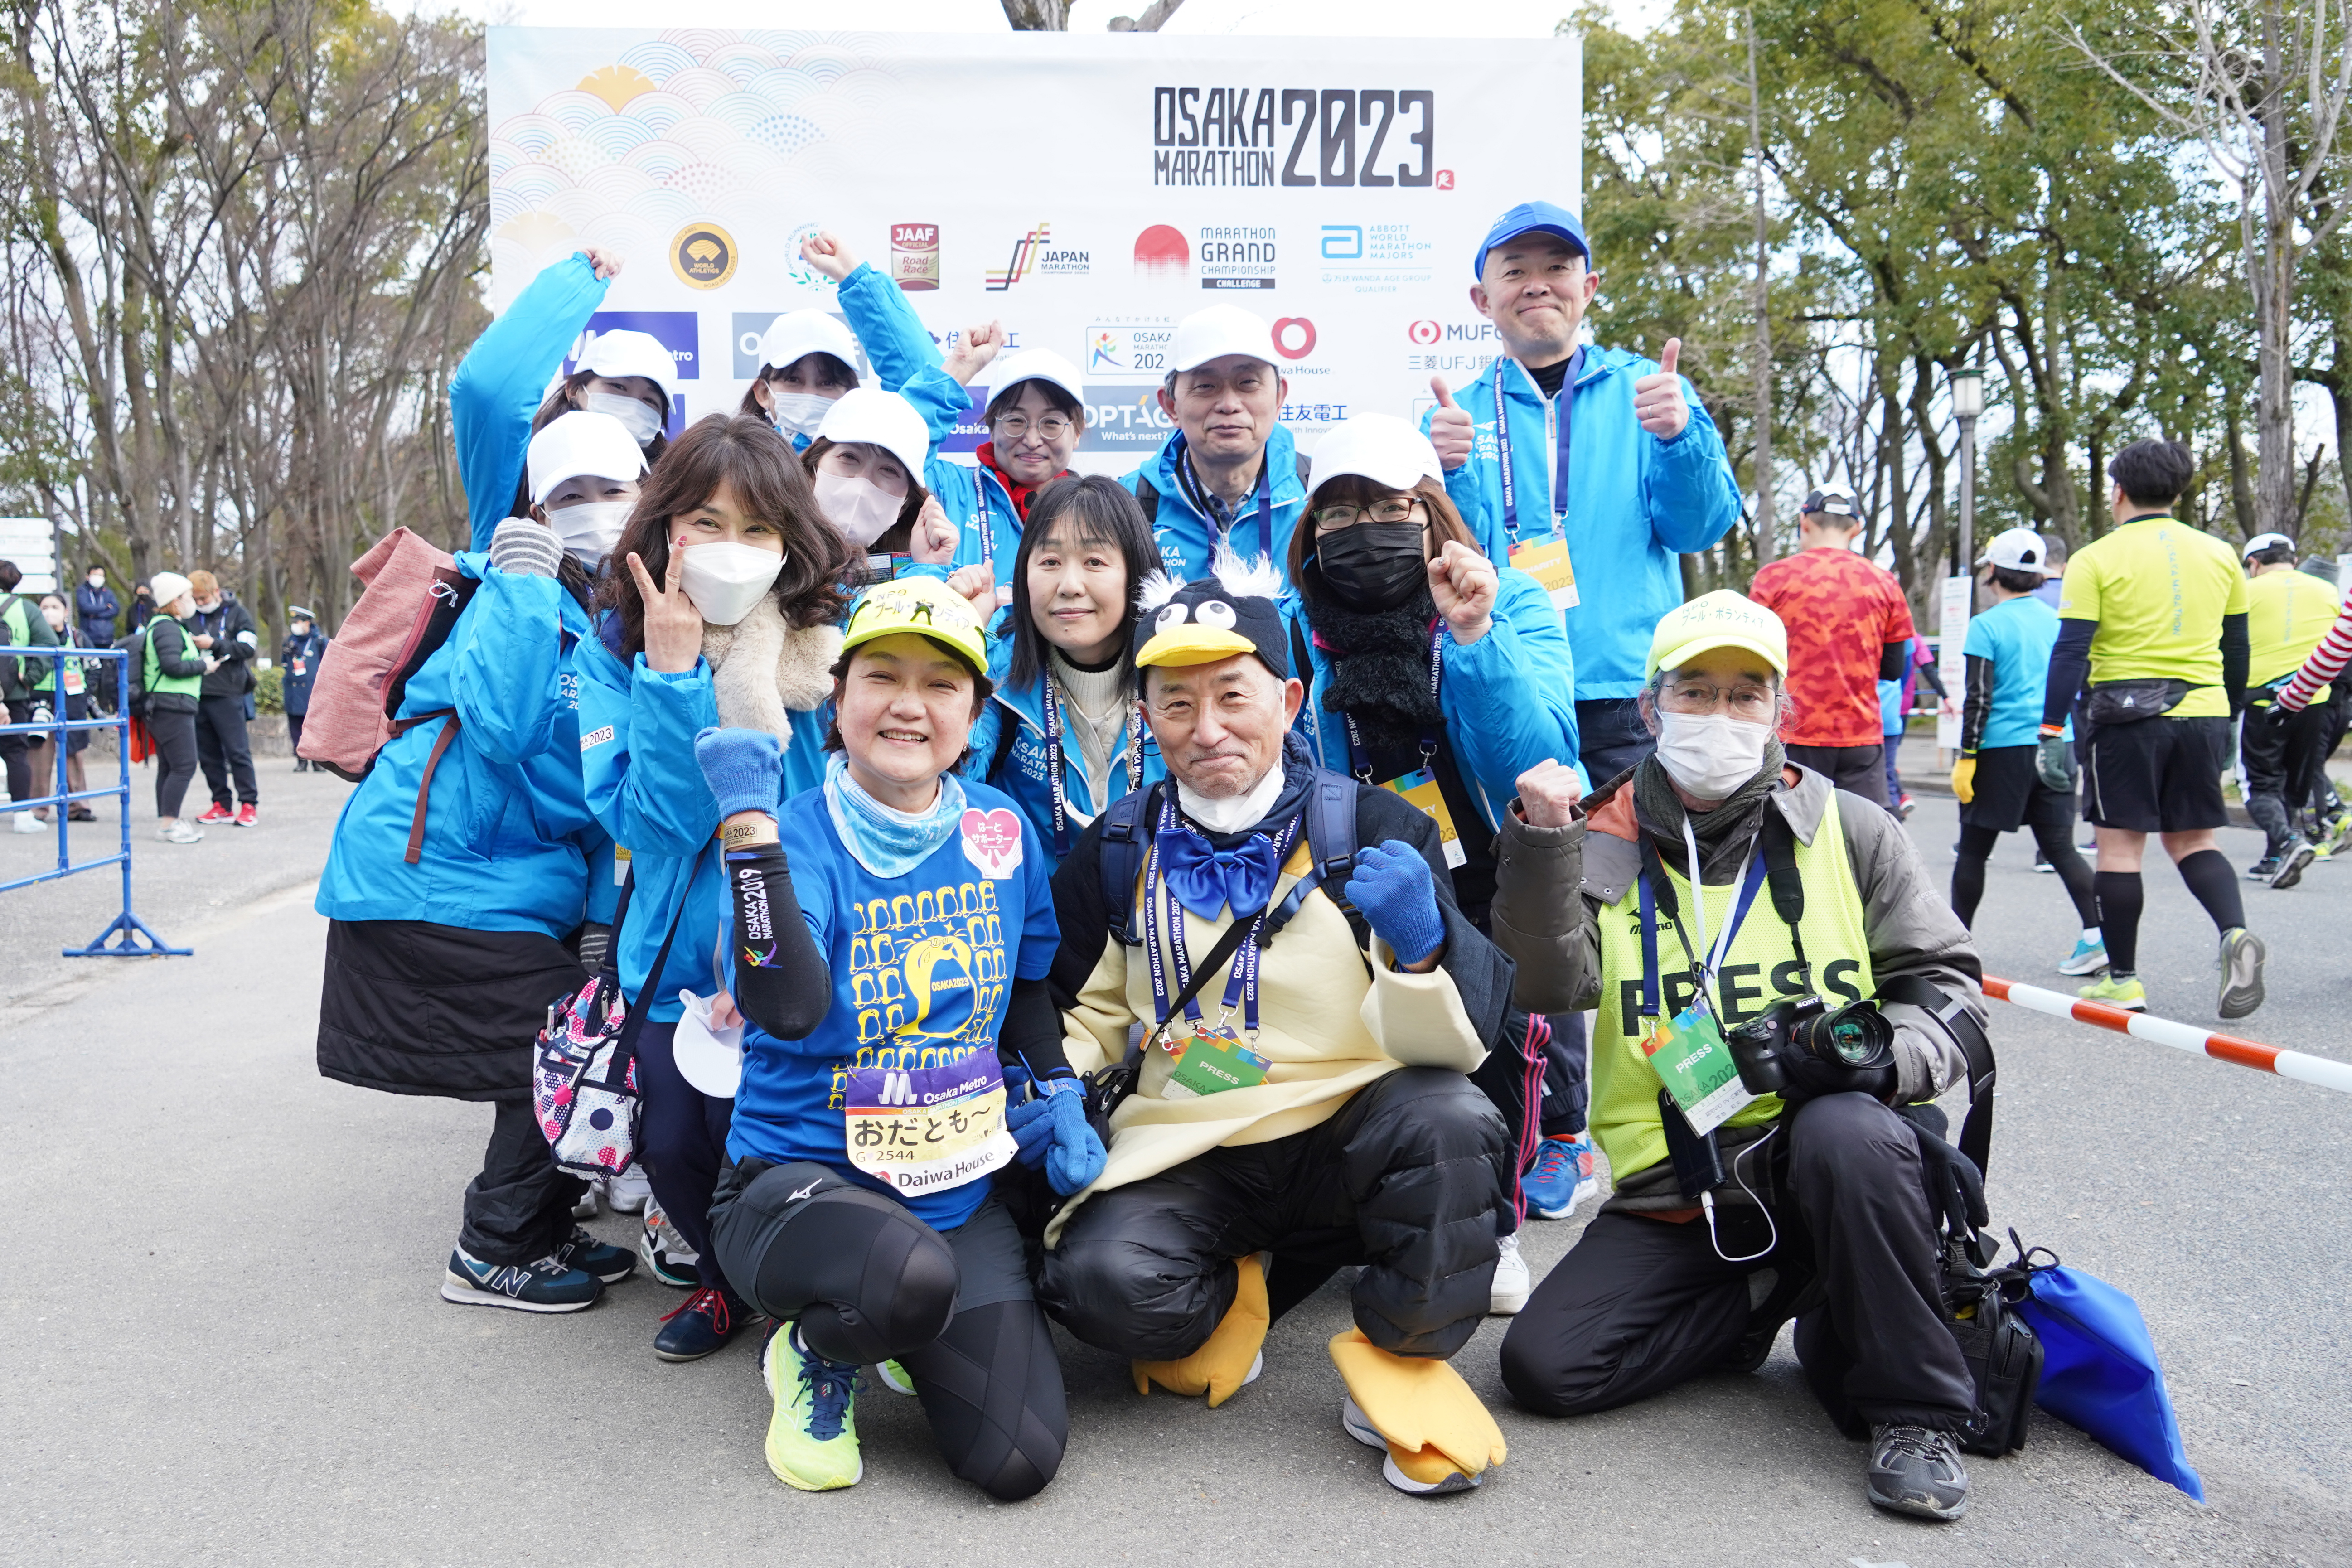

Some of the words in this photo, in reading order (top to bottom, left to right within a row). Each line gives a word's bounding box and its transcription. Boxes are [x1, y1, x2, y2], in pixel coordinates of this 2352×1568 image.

[1155, 87, 1274, 147] OSAKA
[1281, 89, 1433, 187] 2023
[1155, 150, 1274, 186] MARATHON
[682, 226, 698, 237] LABEL
[788, 222, 818, 242] RUNNING
[895, 227, 934, 242] JAAF
[1201, 227, 1276, 239] MARATHON
[784, 243, 794, 271] WORLD
[902, 256, 929, 265] Road
[1041, 252, 1089, 263] JAPAN
[1202, 243, 1276, 262] GRAND
[720, 272, 731, 283] RACE
[903, 265, 929, 274] Race
[1201, 266, 1276, 275] CHAMPIONSHIP
[1216, 279, 1262, 288] CHALLENGE
[1134, 333, 1171, 342] OSAKA
[669, 350, 693, 362] tro
[1134, 354, 1164, 368] 202
[1296, 366, 1330, 374] House
[1278, 404, 1348, 421] 住友電工
[1498, 414, 1506, 434] OSAKA
[1138, 431, 1168, 441] next?
[1500, 438, 1508, 452] 2023
[1502, 452, 1511, 486] MARATHON
[981, 523, 990, 554] MARATHON
[1544, 576, 1574, 592] 2023
[1682, 601, 1709, 614] NPO
[2173, 579, 2182, 636] MARATHON
[1434, 633, 1443, 649] 2023
[1430, 650, 1441, 694] MARATHON
[590, 728, 612, 745] 2023
[1350, 730, 1360, 746] 2023
[1016, 737, 1047, 760] OSAK
[1011, 745, 1048, 771] MARATH
[1021, 765, 1045, 781] 2023
[1052, 762, 1062, 804] MARATHON
[733, 826, 755, 838] 2023
[978, 822, 1003, 832] はーと
[971, 834, 1013, 844] サポーター
[739, 868, 767, 901] 2019
[1147, 871, 1156, 889] 2023
[743, 901, 761, 940] OSAKA
[758, 900, 773, 939] MARATHON
[1172, 916, 1186, 964] MARATHON
[1148, 928, 1161, 972] MARATHON
[931, 978, 969, 992] OSAKA2023
[1154, 973, 1164, 997] 2023
[1621, 959, 1861, 1036] PRESS
[1795, 996, 1820, 1008] SONY
[1675, 1043, 1713, 1074] PRESS
[1174, 1071, 1205, 1092] OSAKA
[1199, 1061, 1240, 1085] PRESS
[923, 1088, 958, 1105] Osaka
[959, 1074, 987, 1094] Metro
[1678, 1081, 1710, 1106] OSAKA
[1709, 1063, 1737, 1089] 202
[927, 1101, 958, 1113] MARATHON
[876, 1150, 915, 1161] 2544
[898, 1169, 953, 1187] Daiwa
[955, 1151, 995, 1178] House
